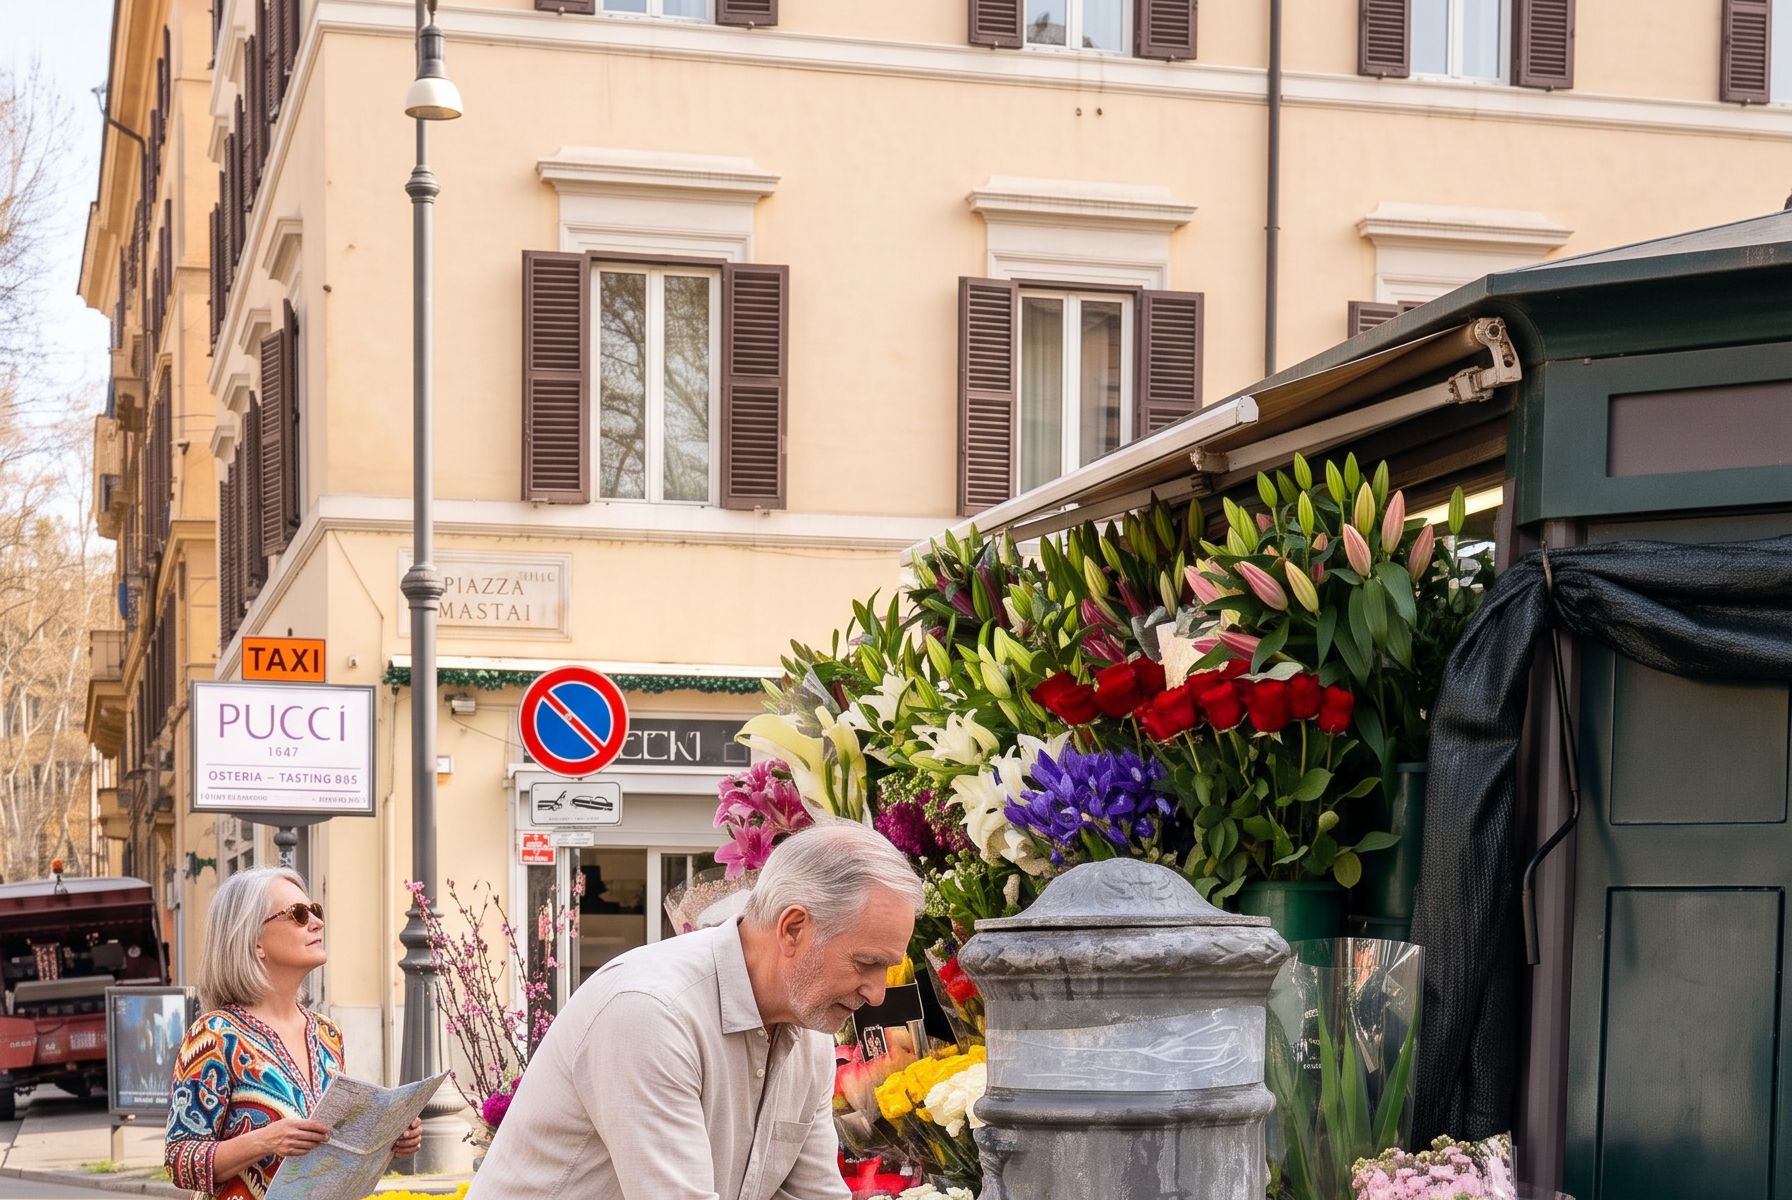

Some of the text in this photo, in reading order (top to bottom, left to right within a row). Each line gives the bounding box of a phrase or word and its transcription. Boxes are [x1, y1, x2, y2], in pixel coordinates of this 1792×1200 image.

[444, 576, 525, 596] PIAZZA
[438, 602, 530, 622] MASTAI
[248, 647, 319, 673] TAXI
[268, 746, 298, 757] 1647
[208, 770, 262, 782] OSTERIA
[279, 772, 331, 784] TASTING
